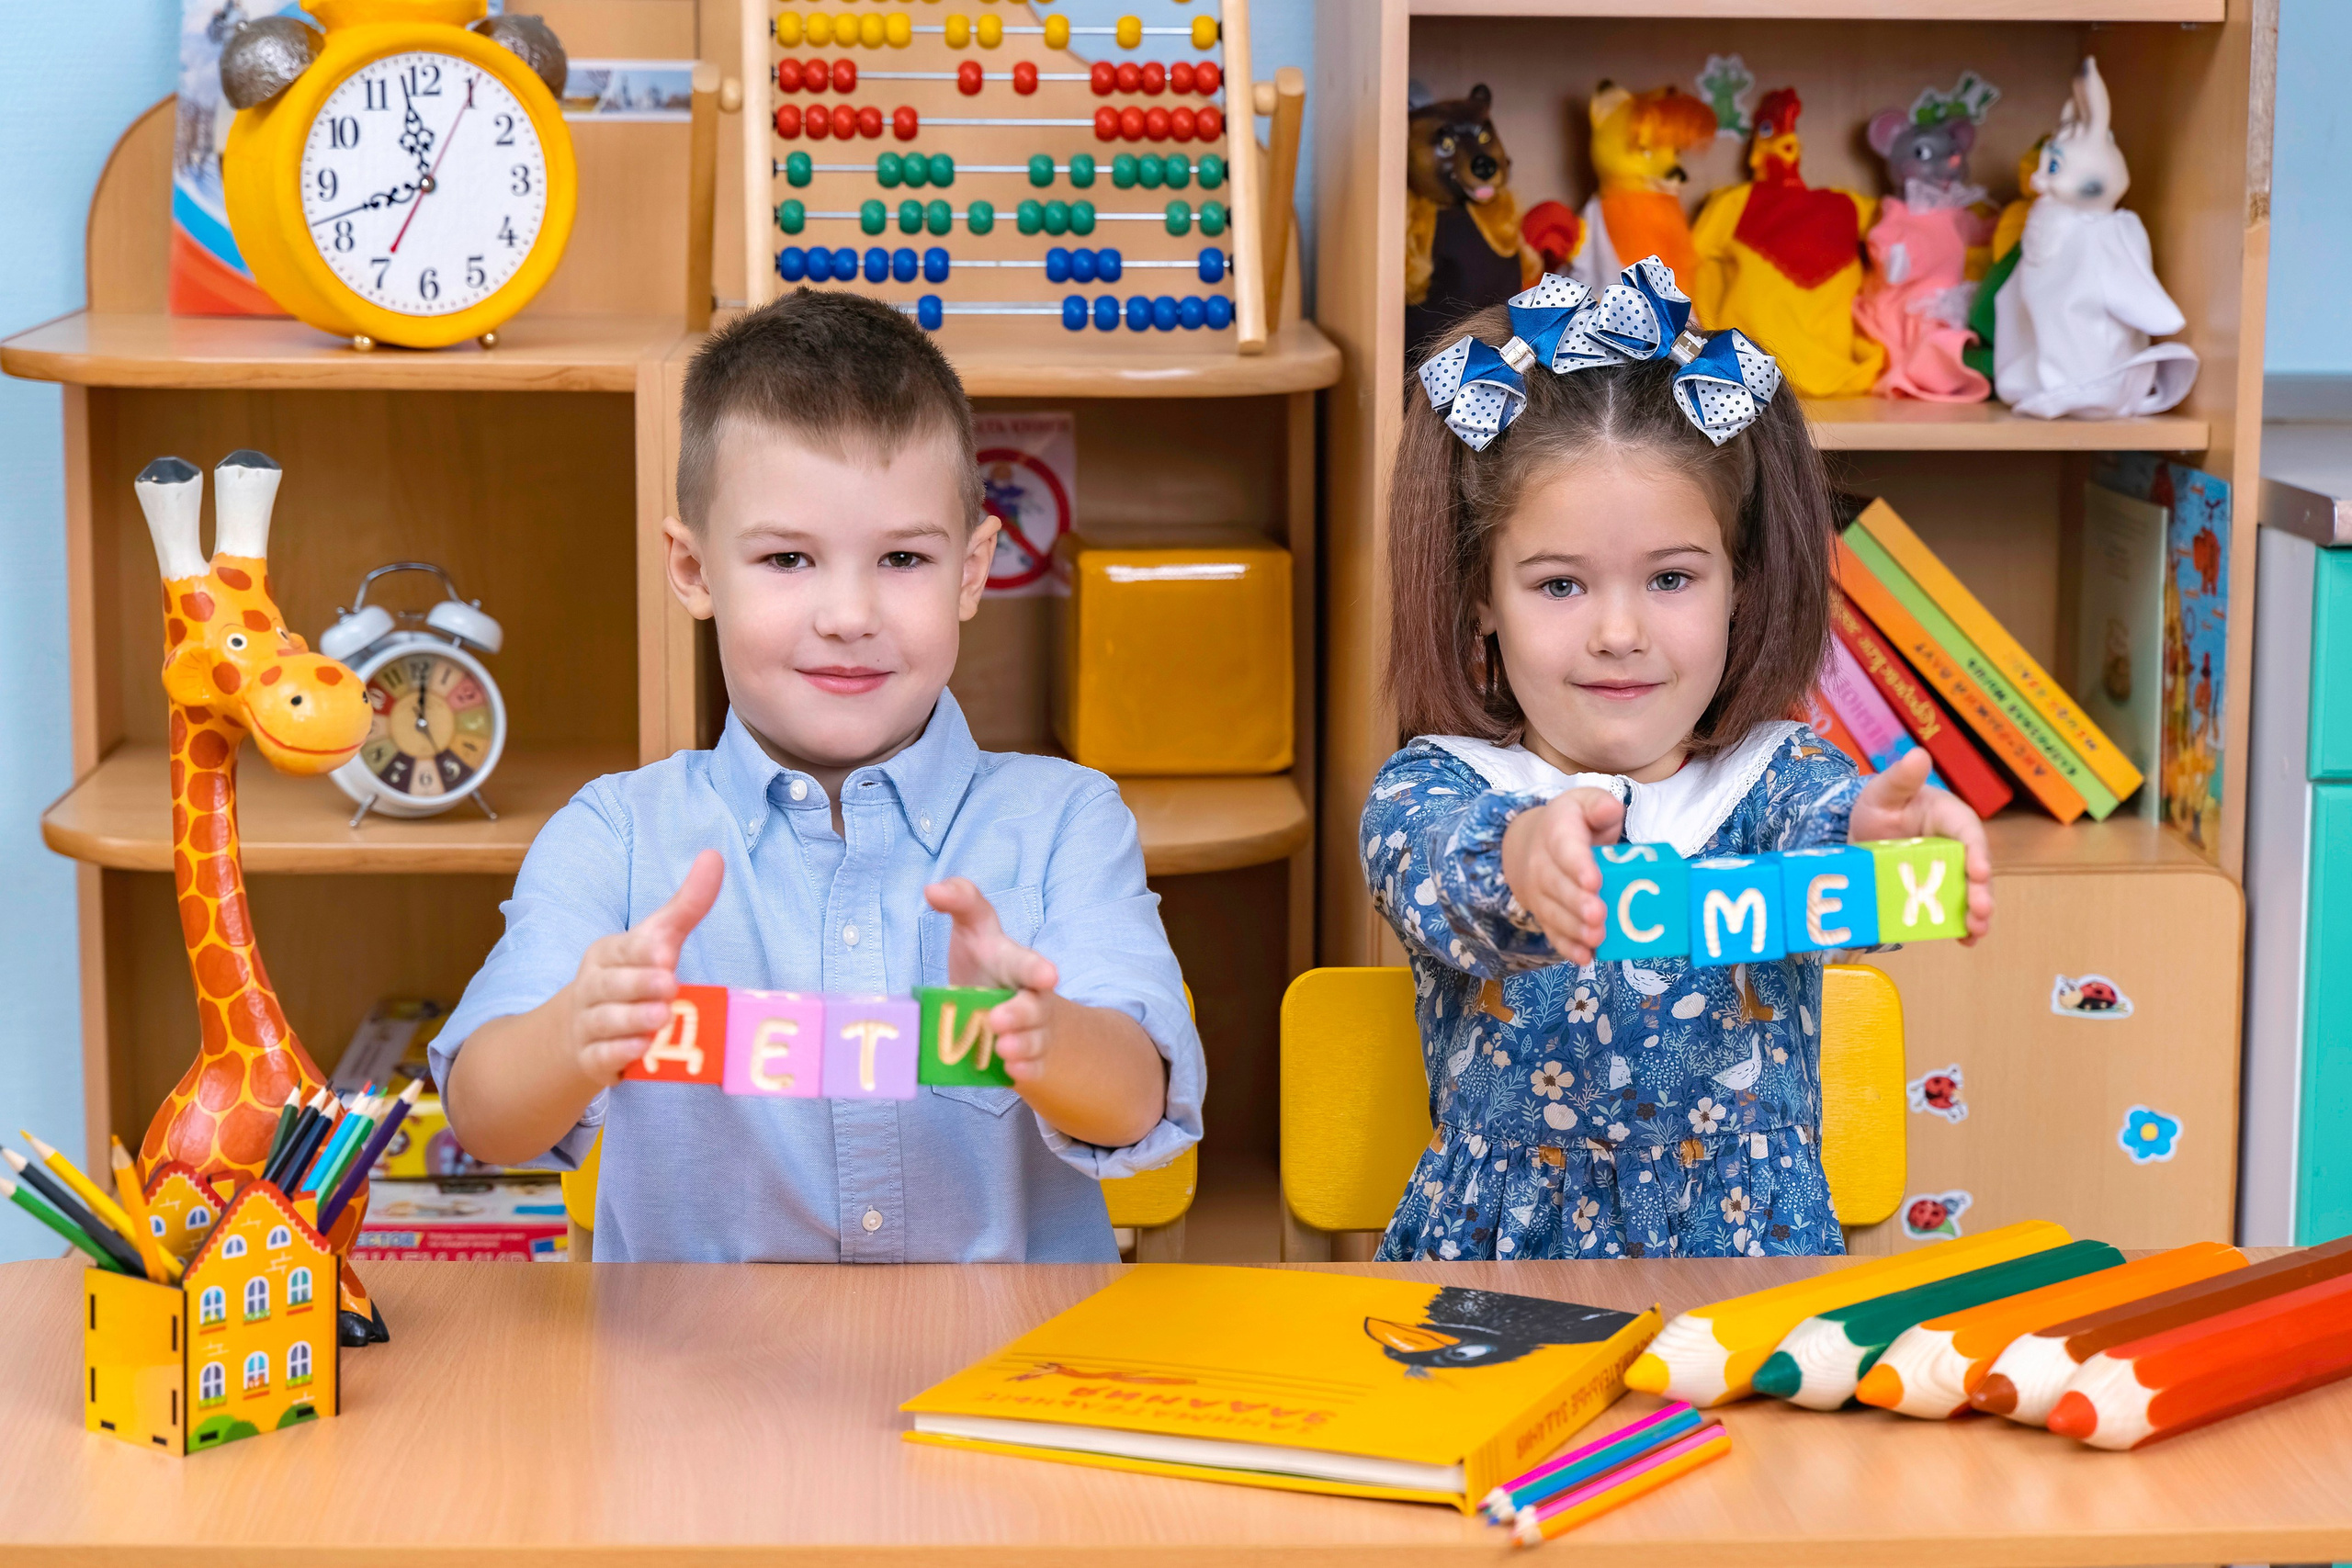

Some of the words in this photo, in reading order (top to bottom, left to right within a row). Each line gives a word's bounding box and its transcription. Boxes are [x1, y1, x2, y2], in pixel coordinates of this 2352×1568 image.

[363, 78, 390, 111] 11
[405, 63, 443, 97] 12
[328, 115, 360, 150] 10
[493, 112, 515, 147] 2
[317, 167, 338, 202] 9
[511, 163, 531, 197] 3
[333, 219, 356, 253] 8
[497, 215, 520, 249] 4
[370, 256, 393, 290] 7
[419, 266, 439, 301] 6
[466, 254, 487, 288] 5
[1617, 860, 1947, 958] СМЕХ
[642, 999, 998, 1091] ДЕТИ
